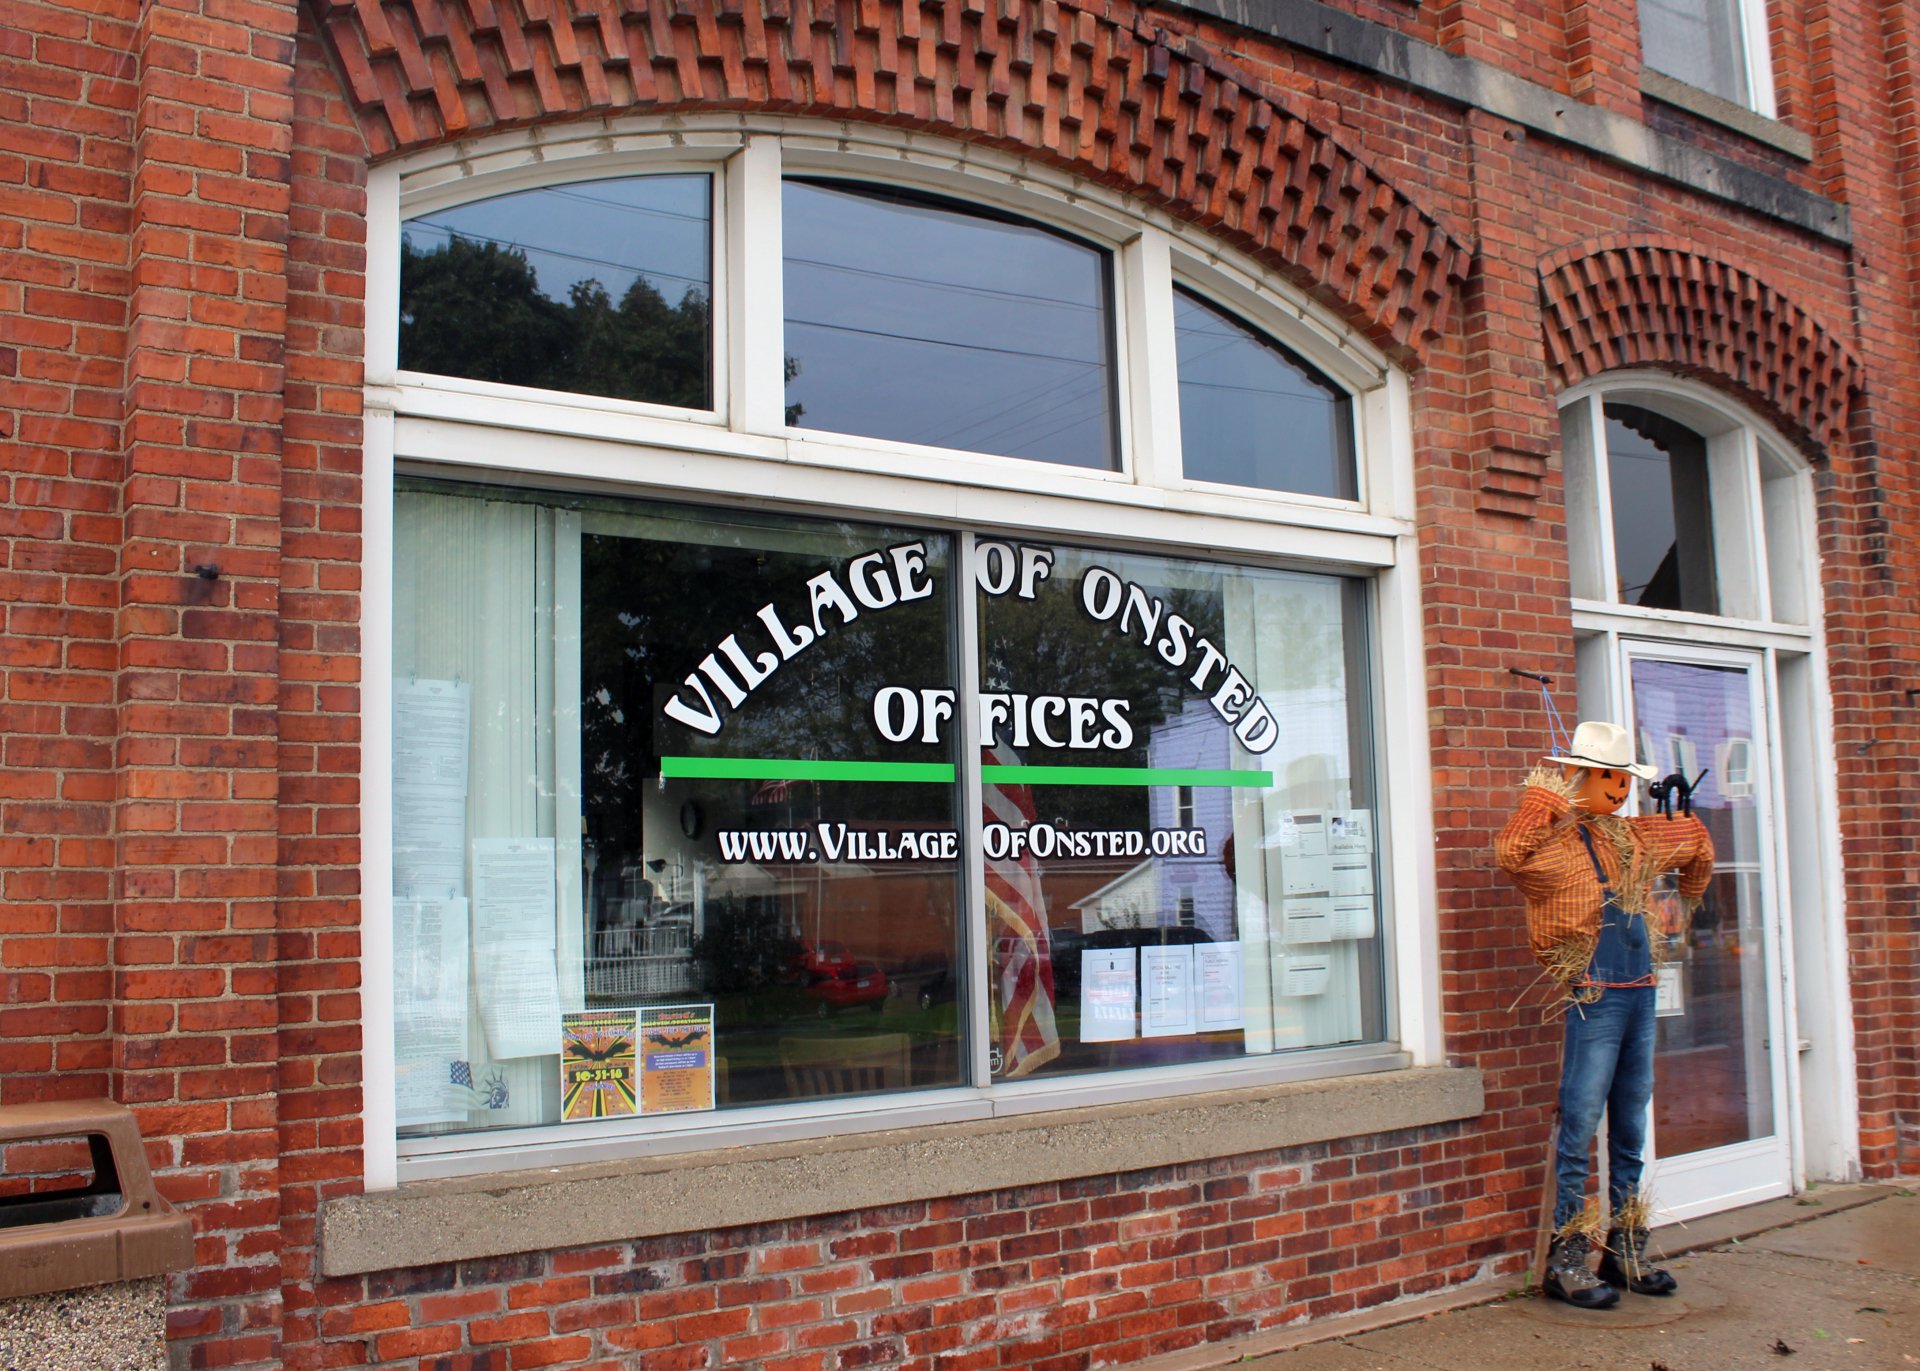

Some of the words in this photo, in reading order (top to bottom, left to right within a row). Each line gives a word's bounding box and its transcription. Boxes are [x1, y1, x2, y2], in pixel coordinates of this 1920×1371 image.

[663, 543, 933, 735] VILLAGE
[975, 542, 1053, 599] OF
[1082, 567, 1279, 754] ONSTED
